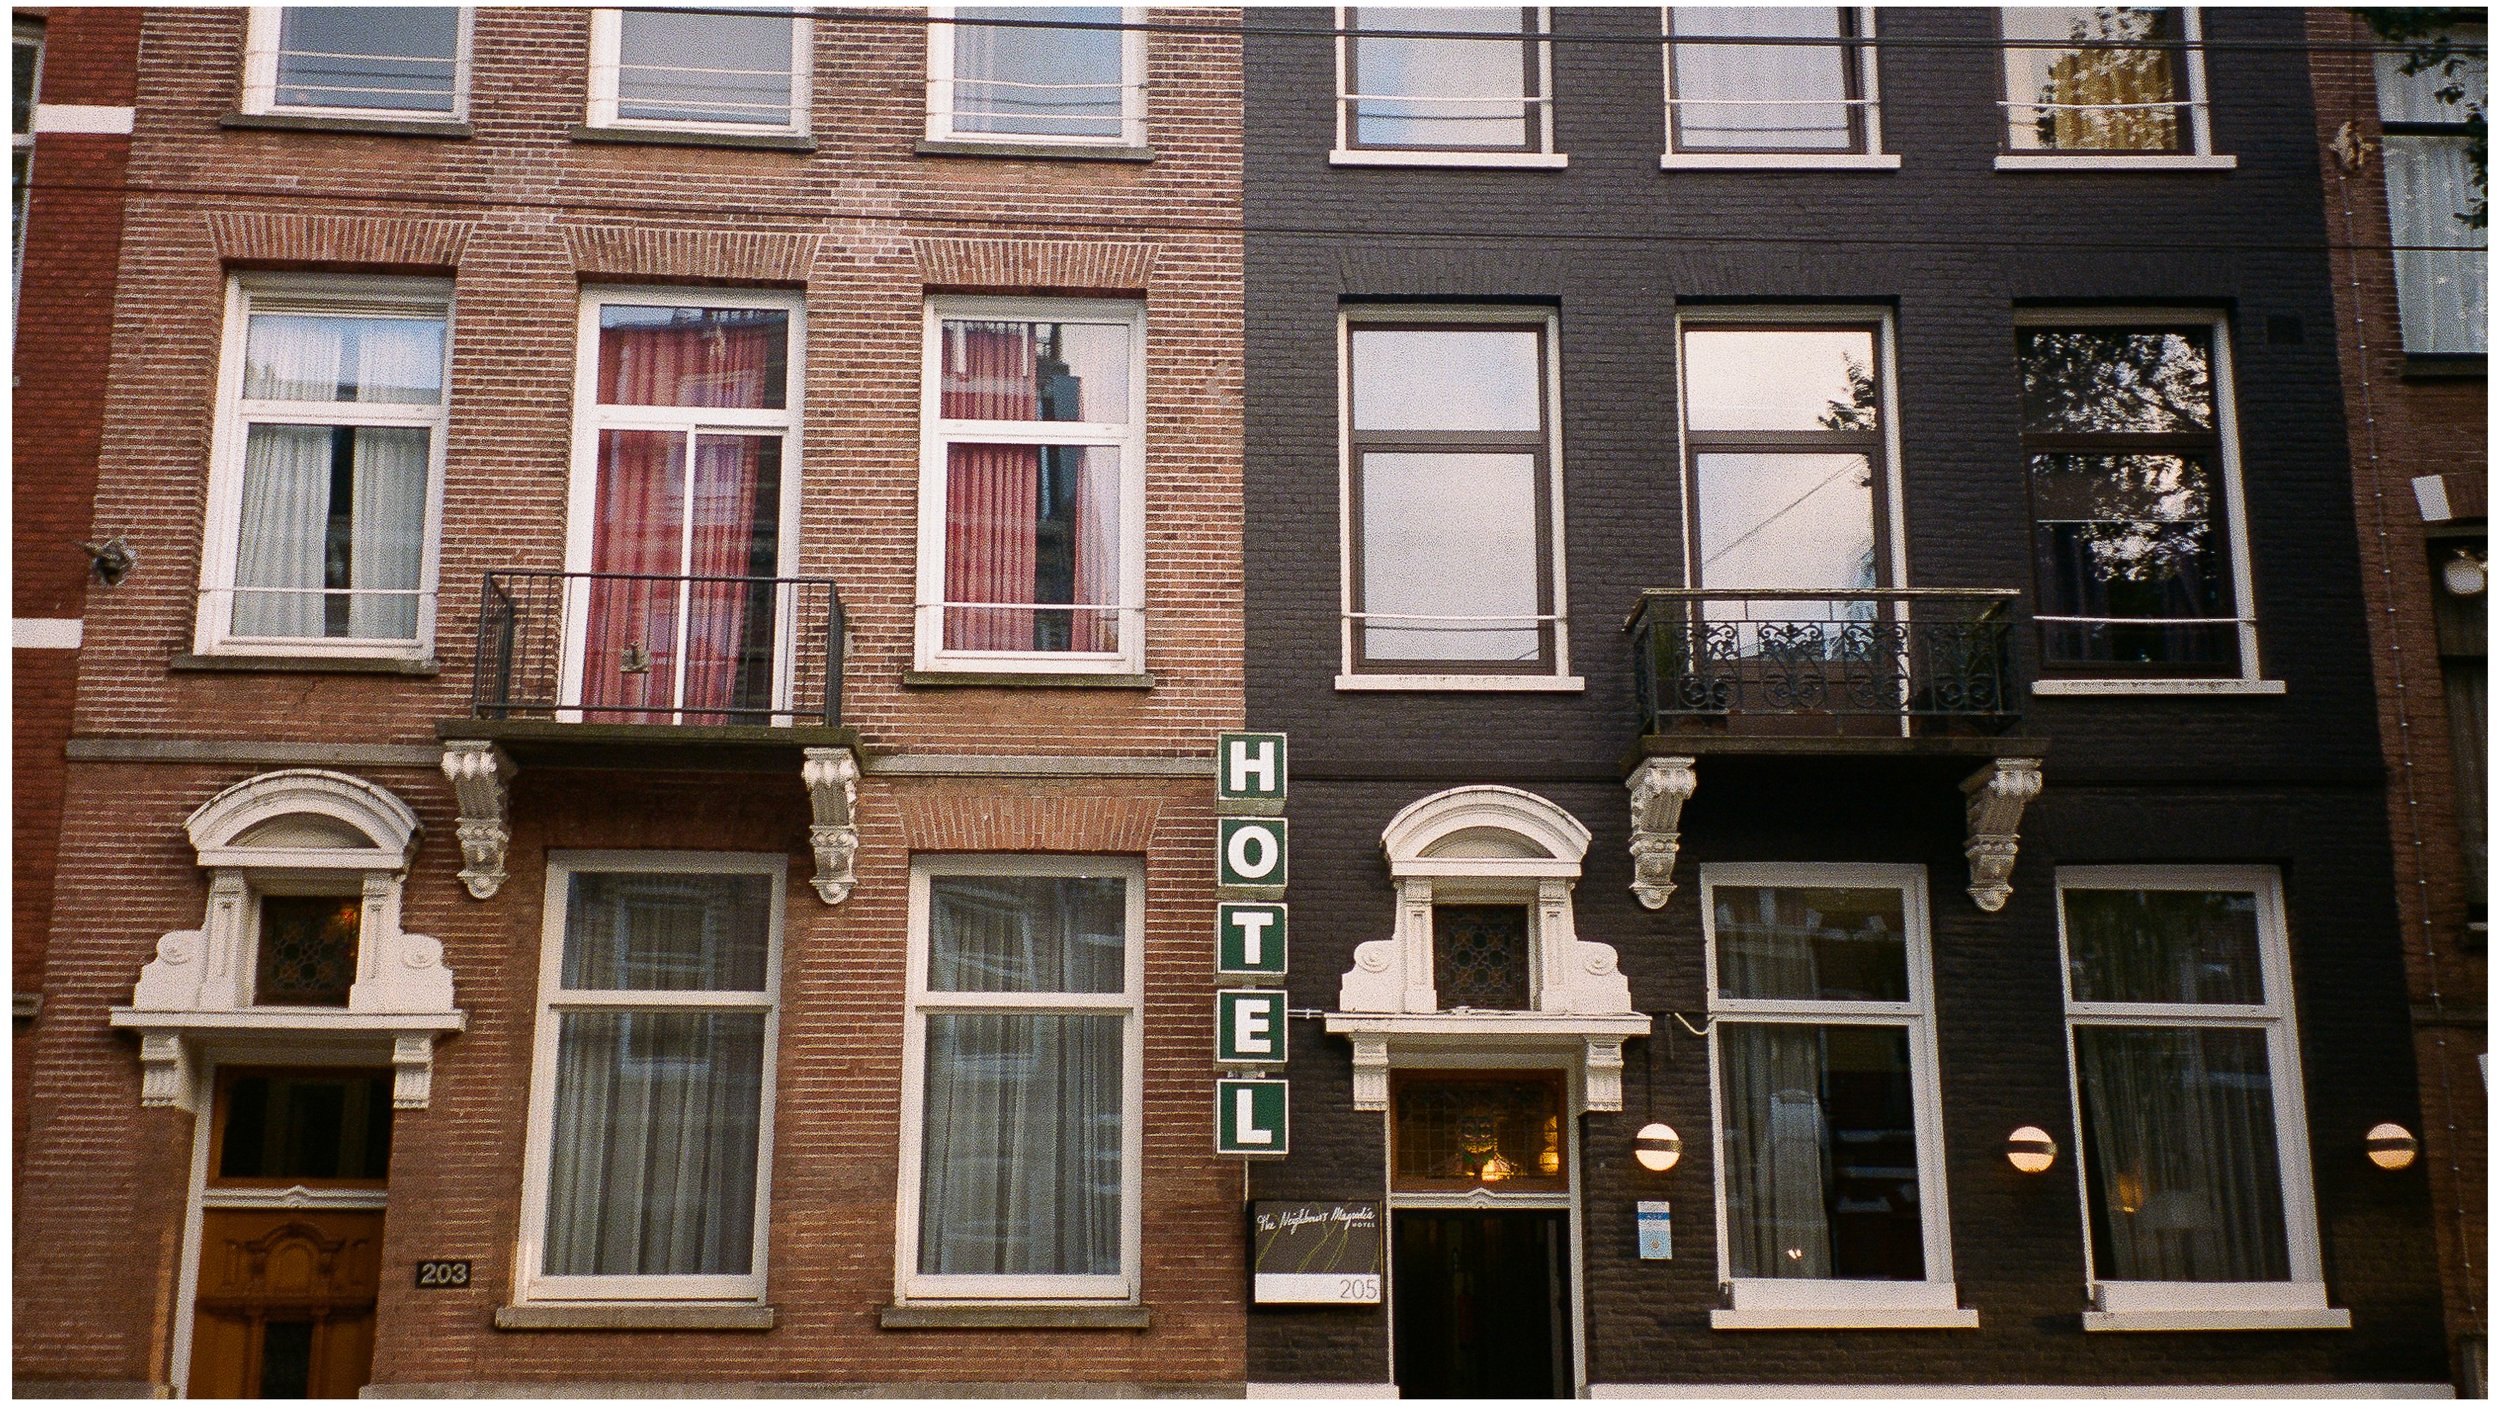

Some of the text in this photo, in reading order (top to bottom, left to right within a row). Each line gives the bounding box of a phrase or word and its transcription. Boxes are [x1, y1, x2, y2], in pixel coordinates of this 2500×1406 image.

[1227, 741, 1279, 1143] HOTEL
[1257, 1214, 1276, 1231] The
[1331, 1207, 1376, 1230] Magnolia
[421, 1263, 467, 1283] 203
[1340, 1279, 1378, 1299] 205
